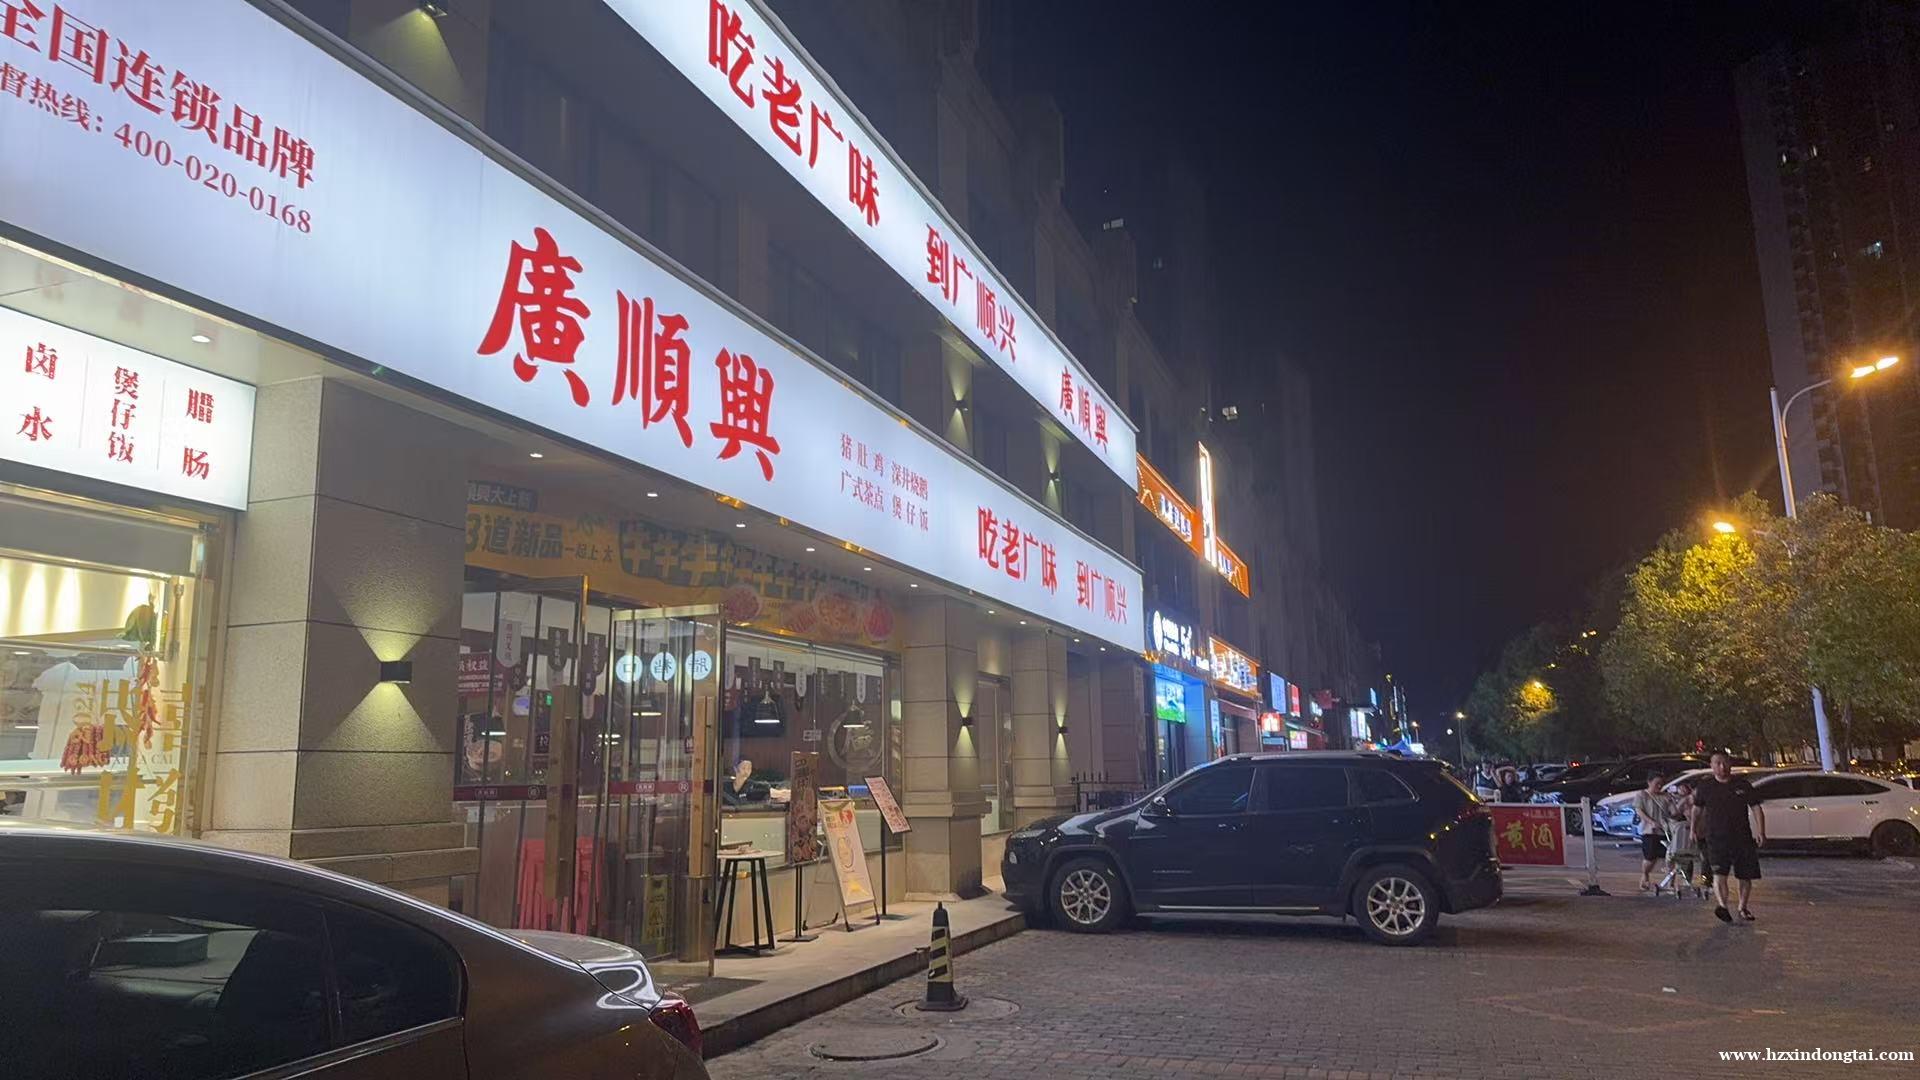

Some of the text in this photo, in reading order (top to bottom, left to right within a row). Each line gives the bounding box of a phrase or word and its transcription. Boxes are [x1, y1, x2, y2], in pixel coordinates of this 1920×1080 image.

[0, 0, 315, 189] 全国连锁品牌
[708, 0, 1109, 455] 吃老广味 到广顺兴 廣順興
[17, 342, 58, 441] 卤水
[476, 226, 781, 482] 廣順興
[107, 366, 139, 464] 煲仔饭
[840, 469, 929, 533] 广式茶点 煲仔饭
[977, 505, 1128, 625] 吃老广味 到广顺兴
